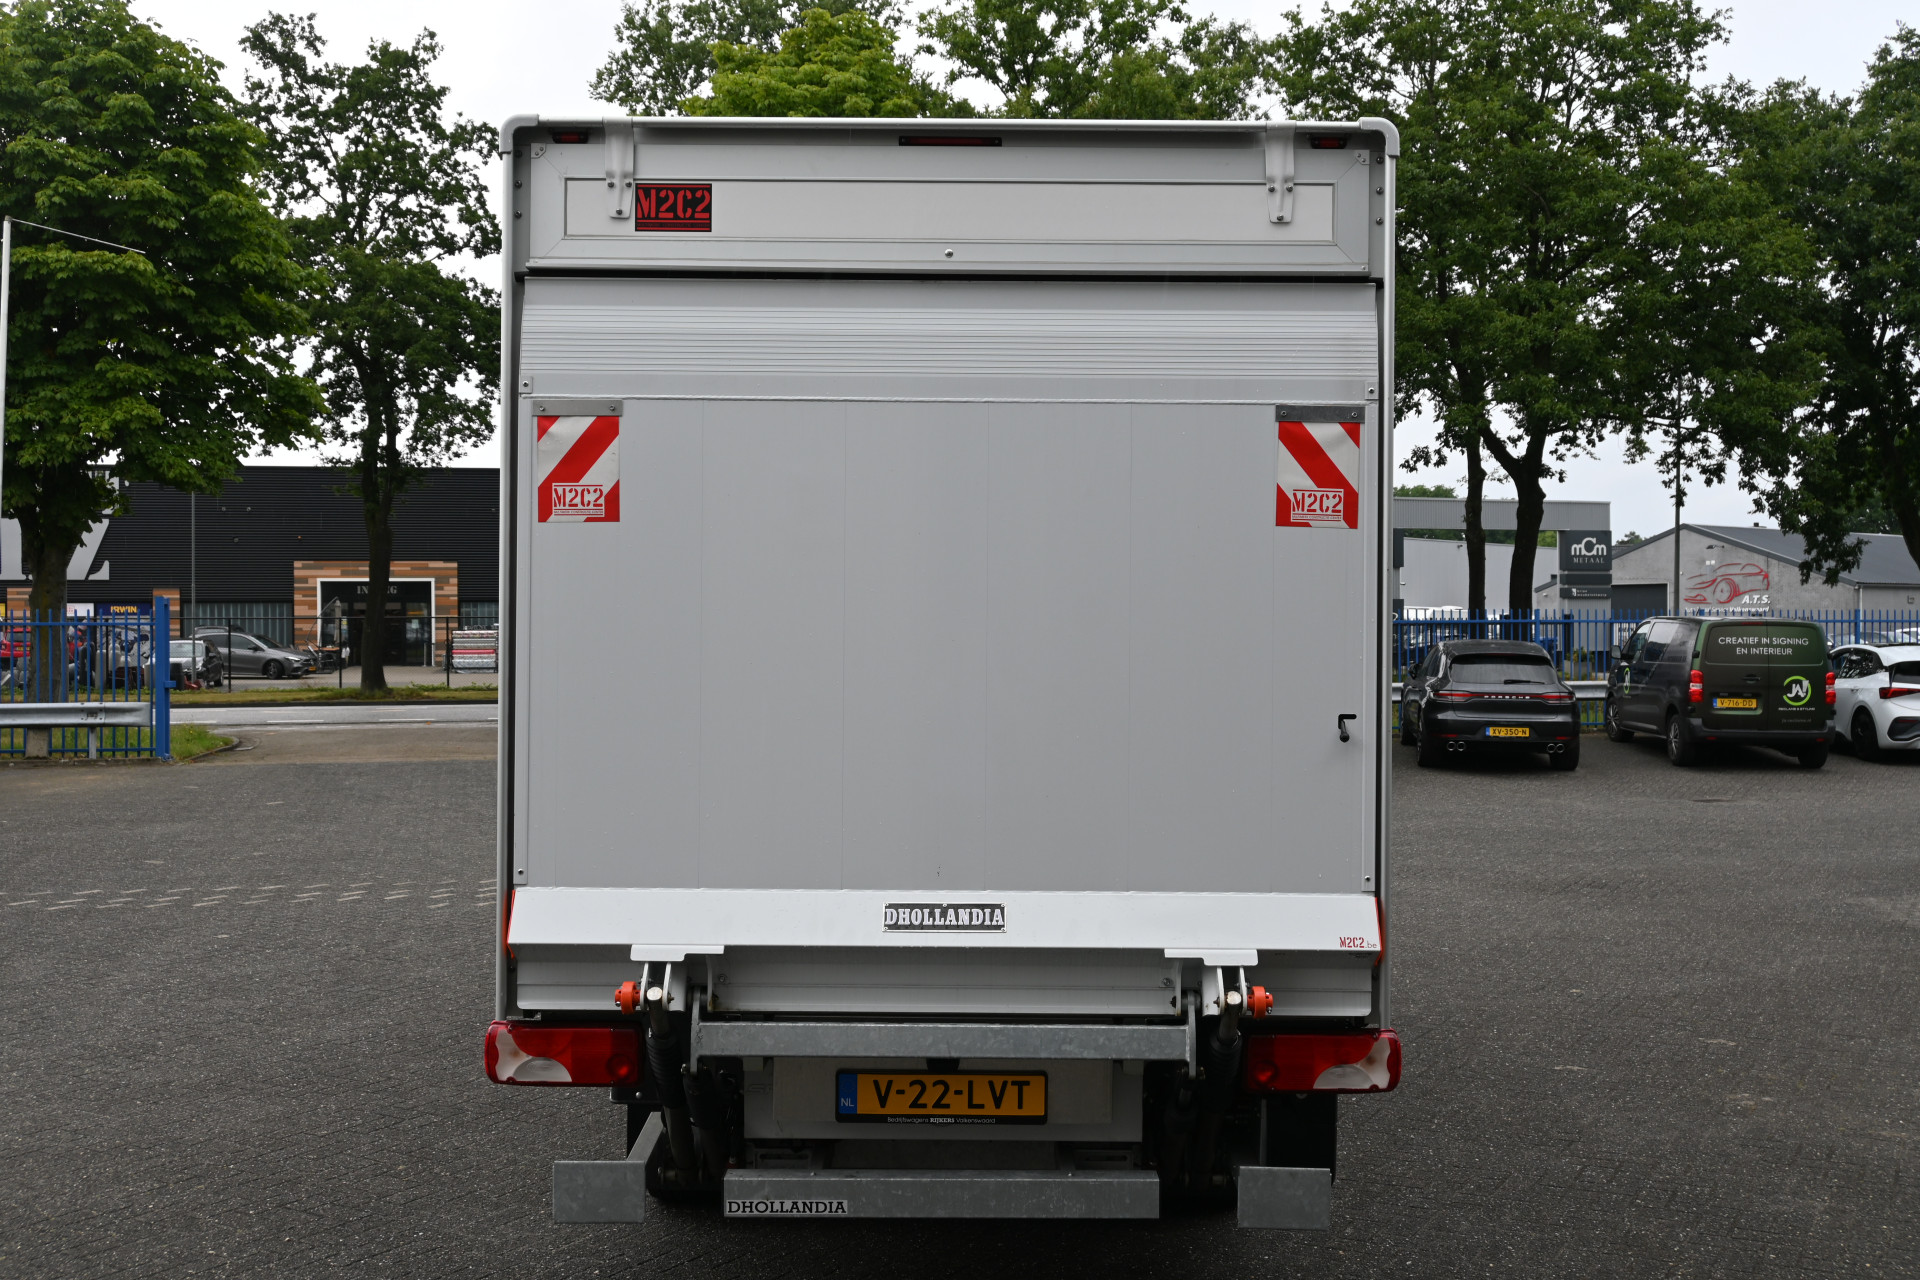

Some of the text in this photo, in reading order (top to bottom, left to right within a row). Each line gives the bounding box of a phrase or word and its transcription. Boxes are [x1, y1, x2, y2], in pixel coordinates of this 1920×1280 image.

[637, 189, 711, 219] M2C2
[553, 488, 604, 507] M2C2
[1292, 492, 1342, 513] M2C2
[1742, 595, 1771, 604] A.T.S.
[1718, 637, 1809, 645] CREATIEF IN SIGNING
[1736, 647, 1793, 655] EN INTERIEUR
[1720, 699, 1754, 707] V-716-DD
[885, 908, 1005, 926] DHOLLANDIA
[872, 1079, 1031, 1110] V-22-LVT
[840, 1097, 855, 1107] NL
[887, 1116, 929, 1124] Bedrijfswagens
[727, 1201, 847, 1214] DHOLLANDIA
